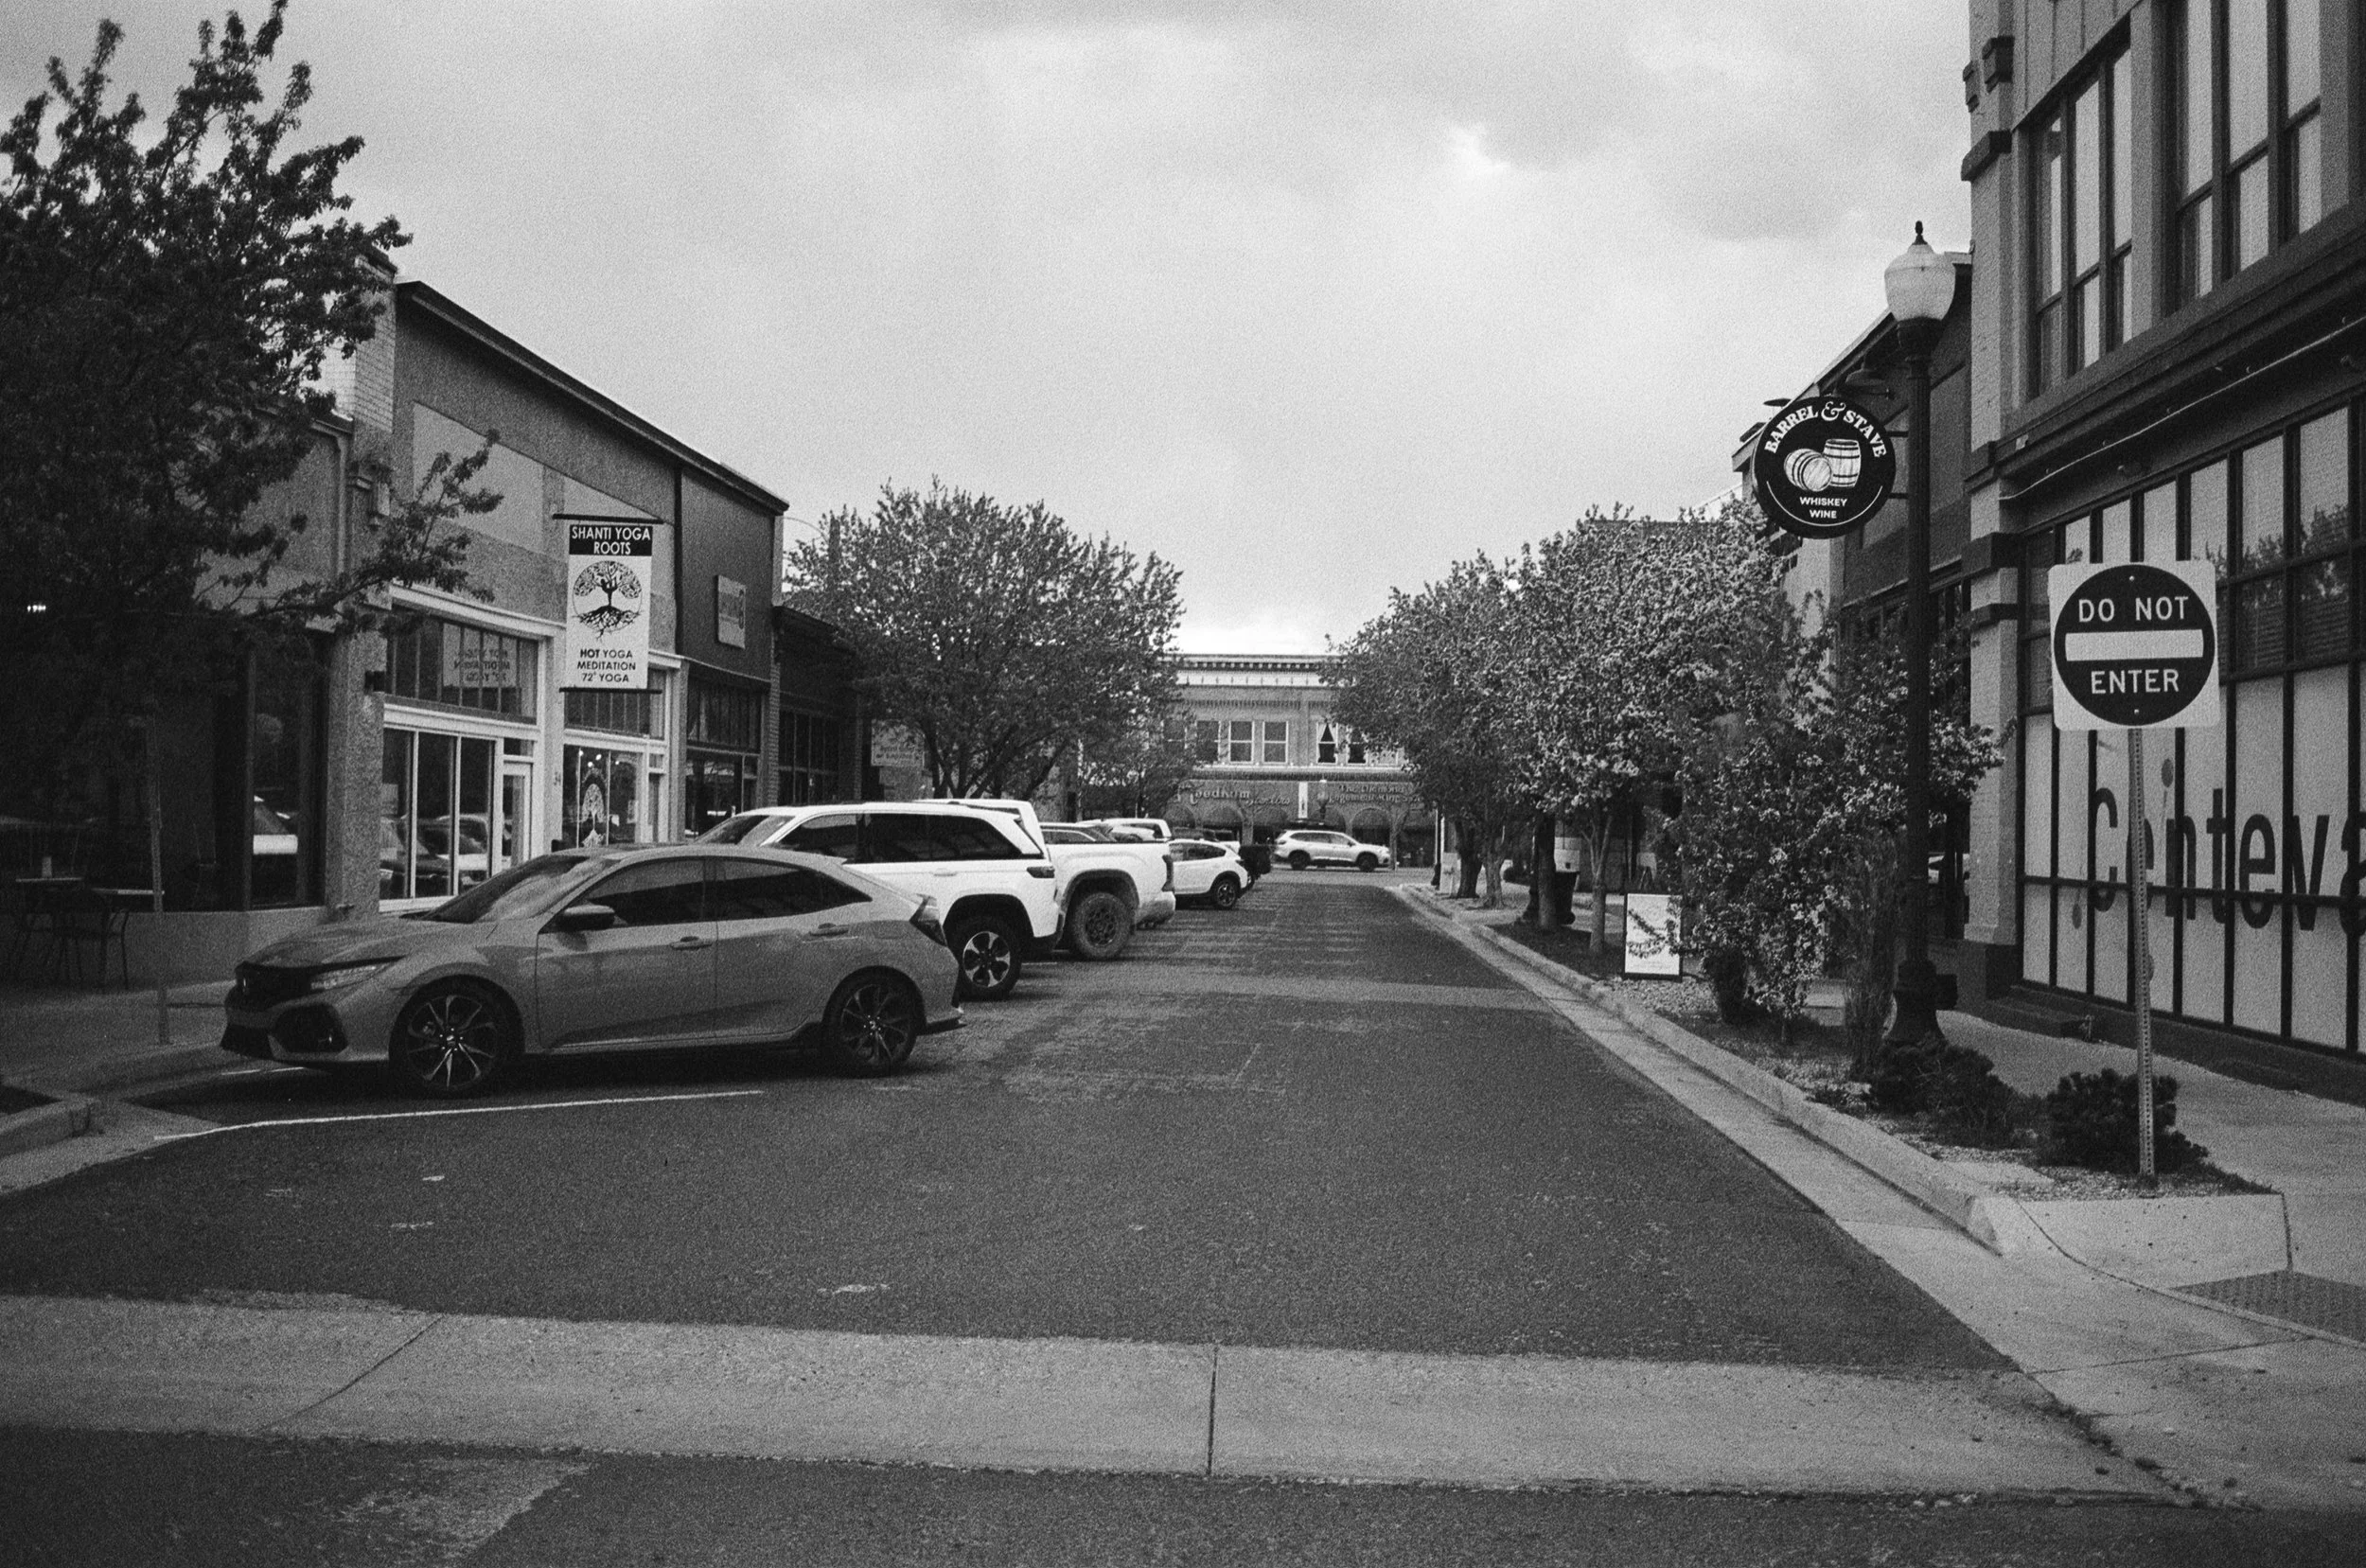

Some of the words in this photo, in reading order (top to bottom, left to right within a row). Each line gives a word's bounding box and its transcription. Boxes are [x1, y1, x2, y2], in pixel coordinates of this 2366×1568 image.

[1764, 405, 1819, 454] BARREL
[1821, 400, 1846, 422] &
[1843, 410, 1887, 458] STAVE
[1799, 496, 1848, 507] WHISKEY
[1809, 509, 1837, 520] WINE
[572, 526, 612, 540] SHANTI
[616, 527, 651, 541] YOGA
[593, 541, 631, 555] ROOTS
[2078, 598, 2115, 623] DO
[2135, 596, 2189, 621] NOT
[580, 648, 600, 659] HOT
[603, 649, 633, 660] YOGA
[576, 661, 636, 671] MEDITATION
[598, 672, 629, 682] YOGA
[2091, 668, 2180, 695] ENTER
